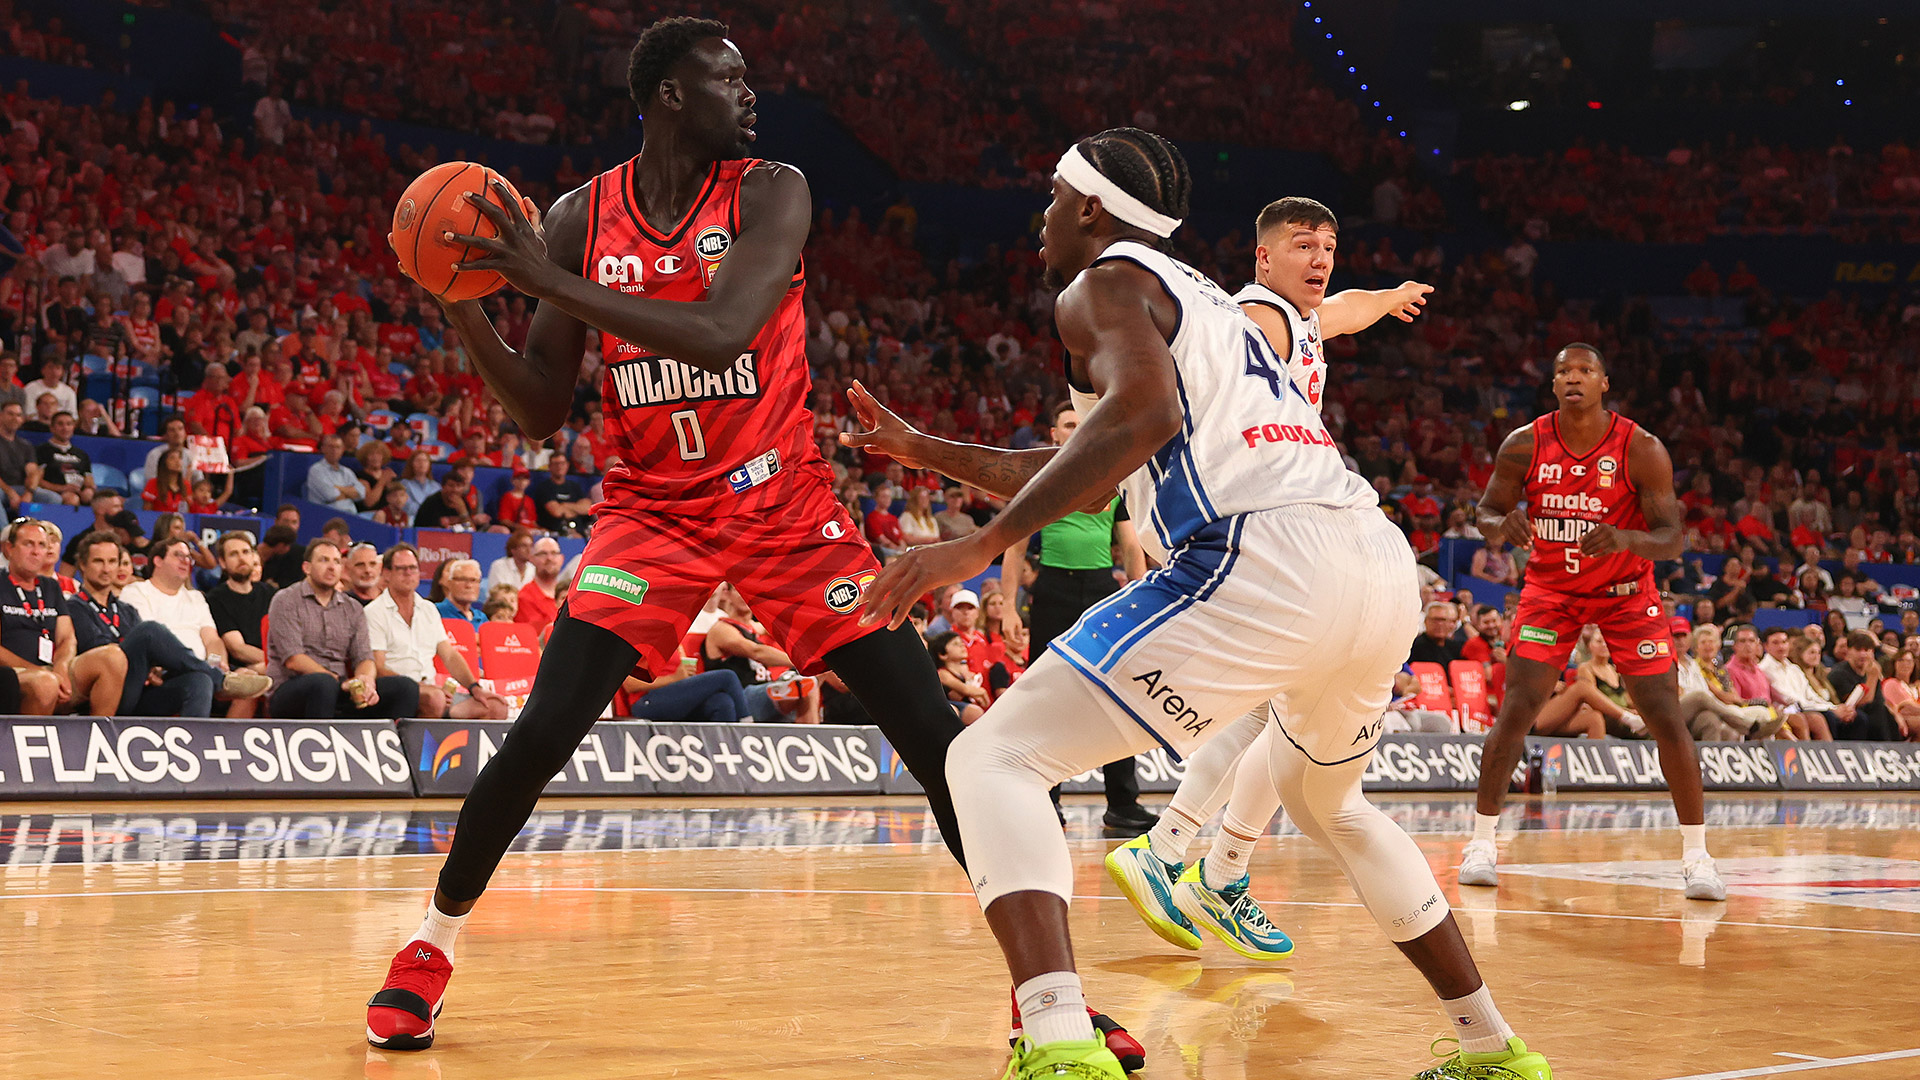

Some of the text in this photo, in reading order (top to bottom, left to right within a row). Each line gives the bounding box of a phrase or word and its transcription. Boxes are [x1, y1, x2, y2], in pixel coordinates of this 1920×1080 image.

[702, 235, 724, 252] NBL
[620, 284, 645, 293] bank
[671, 410, 707, 461] 0
[1534, 518, 1600, 542] WILDC
[1565, 547, 1580, 574] 5
[583, 572, 642, 596] HOLMAN
[831, 586, 854, 606] NBL
[1564, 743, 1618, 784] ALL
[1798, 746, 1847, 784] ALL
[1421, 894, 1438, 912] ONE
